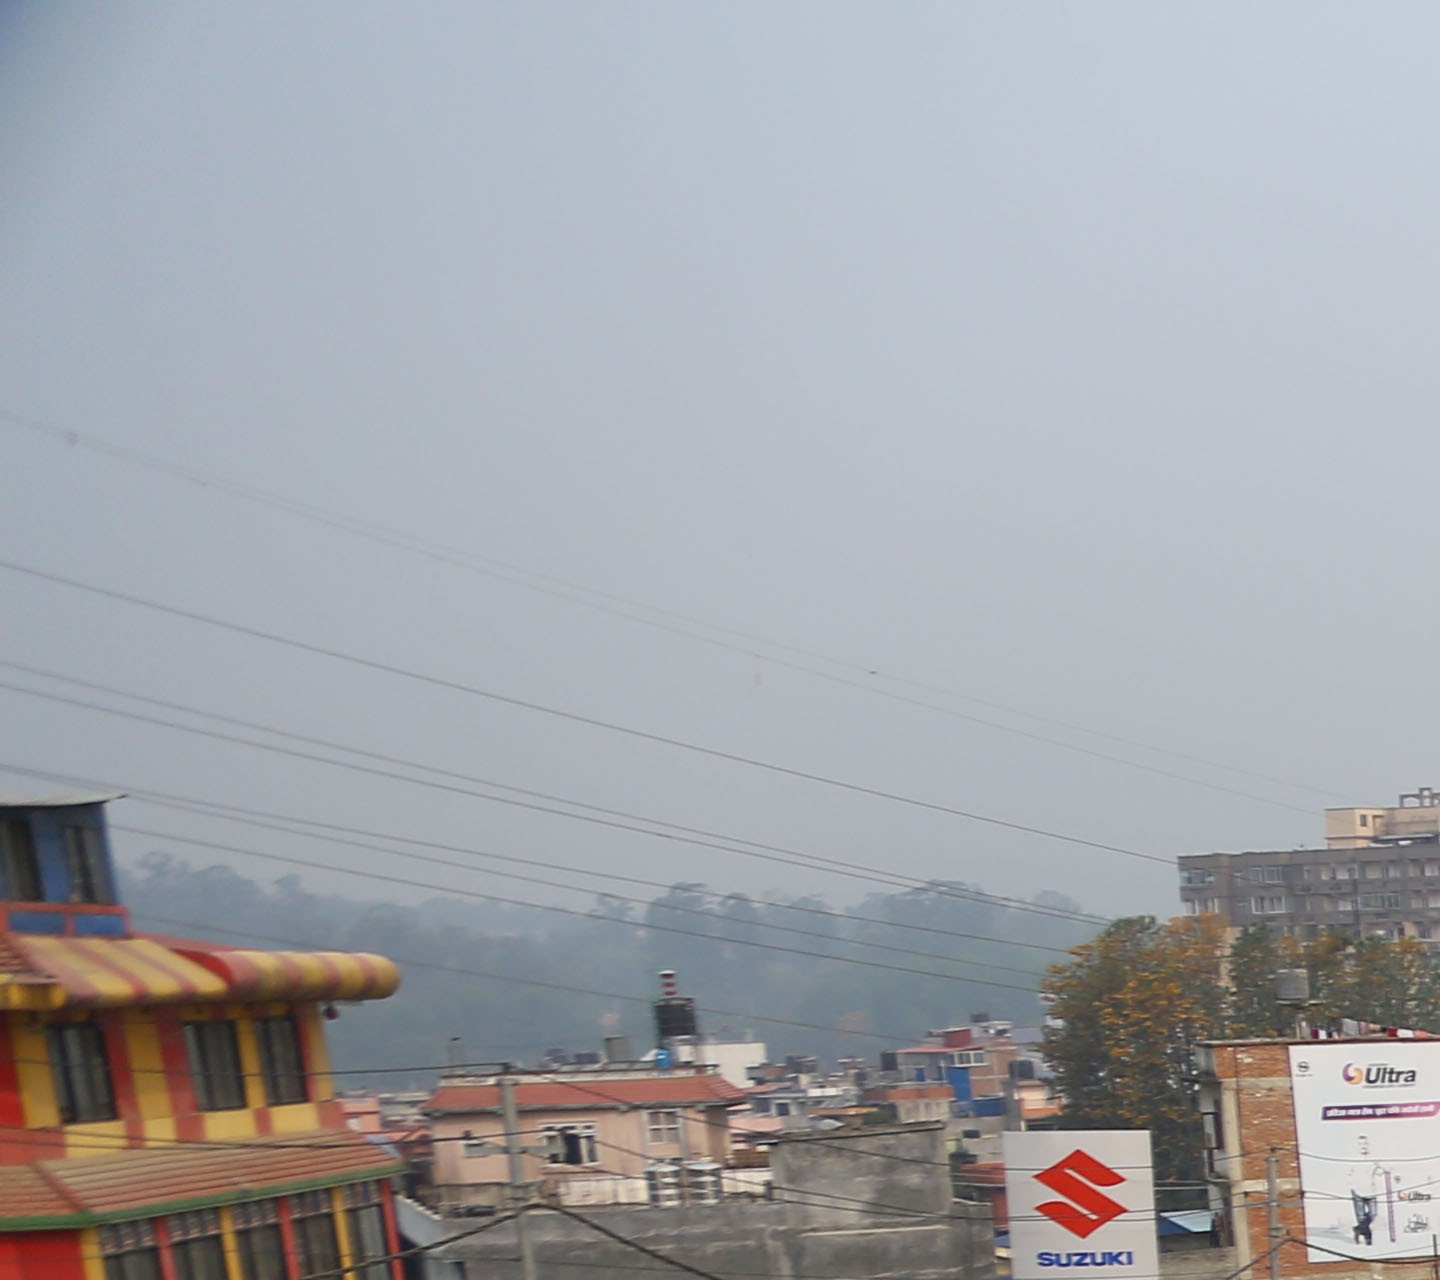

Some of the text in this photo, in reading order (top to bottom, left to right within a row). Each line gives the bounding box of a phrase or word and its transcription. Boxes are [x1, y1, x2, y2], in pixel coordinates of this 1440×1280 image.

[1365, 1066, 1416, 1084] Ultra
[1407, 1190, 1431, 1201] Ultra
[1037, 1251, 1133, 1267] SUZUKI
